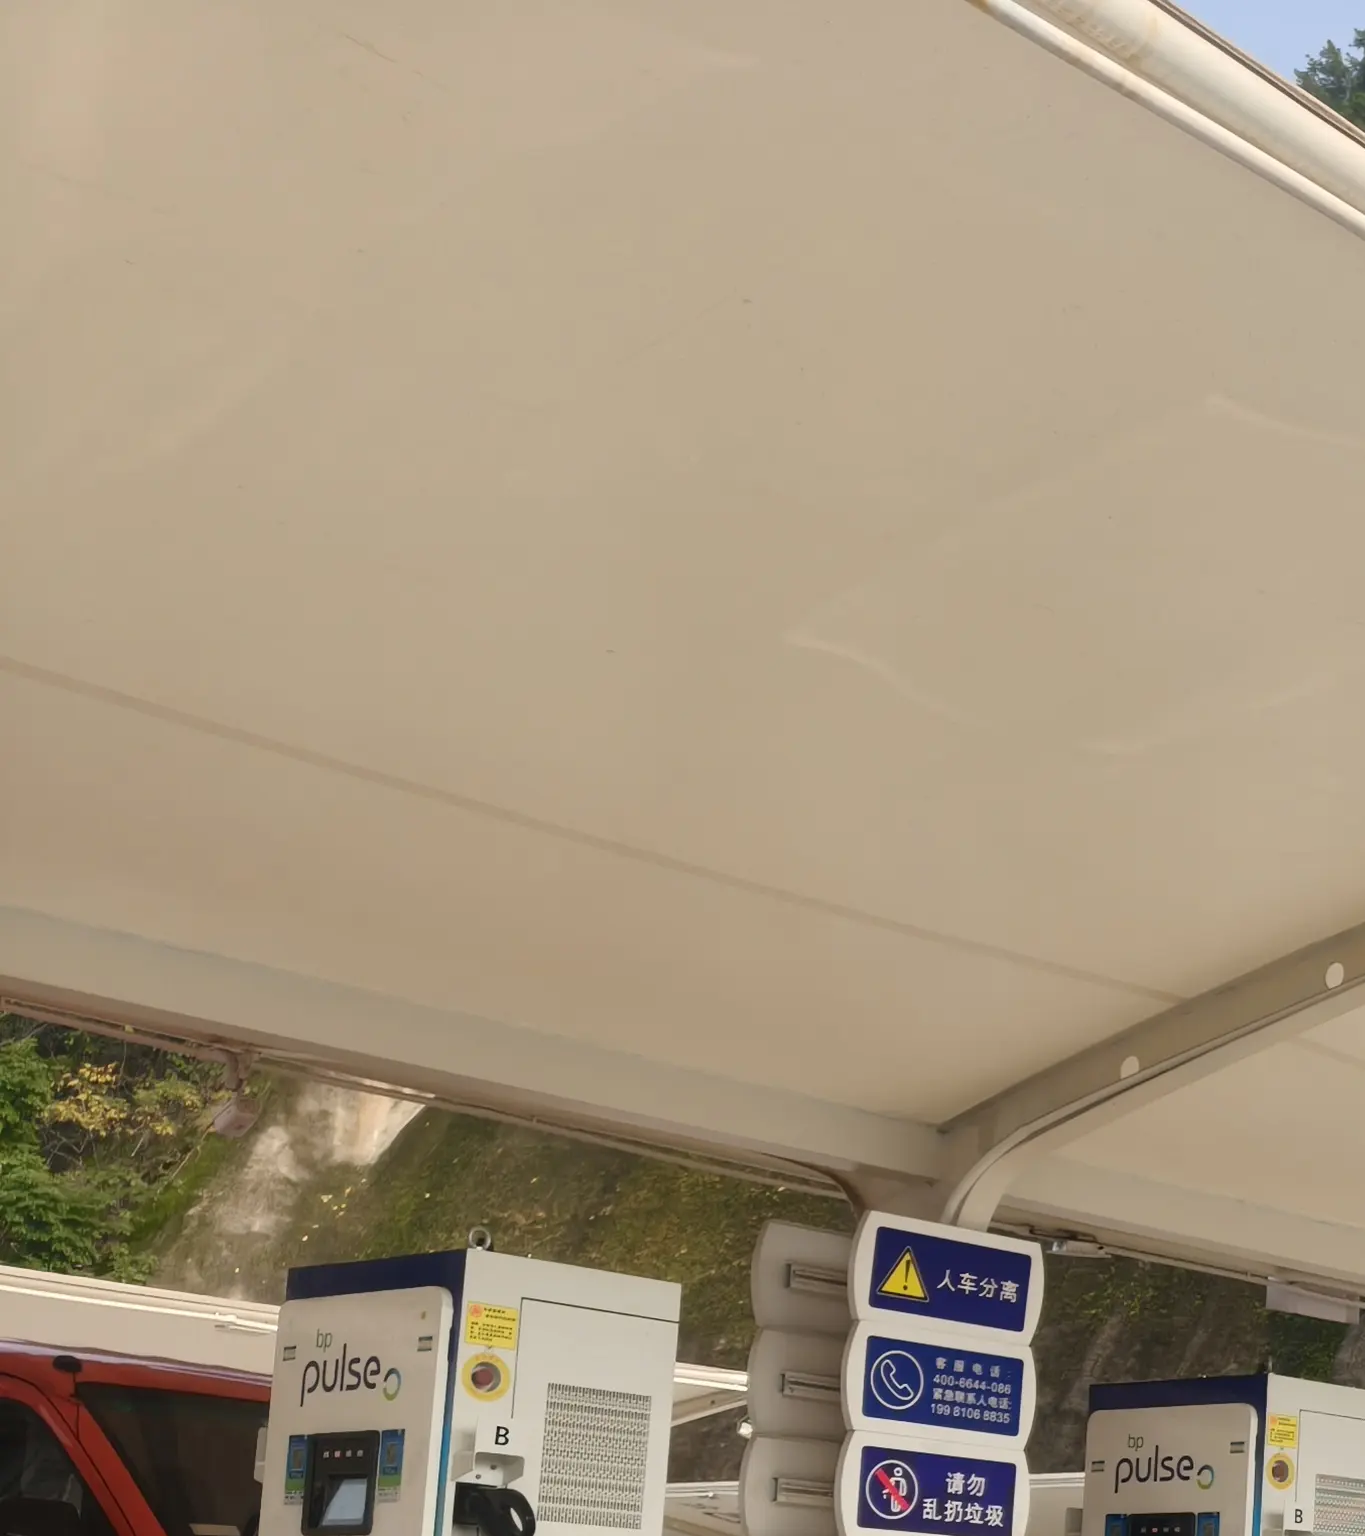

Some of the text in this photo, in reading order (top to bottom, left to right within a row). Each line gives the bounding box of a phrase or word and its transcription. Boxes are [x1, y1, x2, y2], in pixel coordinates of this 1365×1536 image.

[936, 1269, 1020, 1303] 人车分离
[316, 1329, 333, 1352] bp
[300, 1343, 381, 1407] pulse
[930, 1403, 950, 1416] 199
[494, 1426, 509, 1446] B
[1127, 1434, 1144, 1451] bp
[1115, 1445, 1194, 1493] pulse
[945, 1472, 986, 1497] 请勿
[922, 1498, 1005, 1528] 乱扔垃圾
[1294, 1508, 1303, 1524] B
